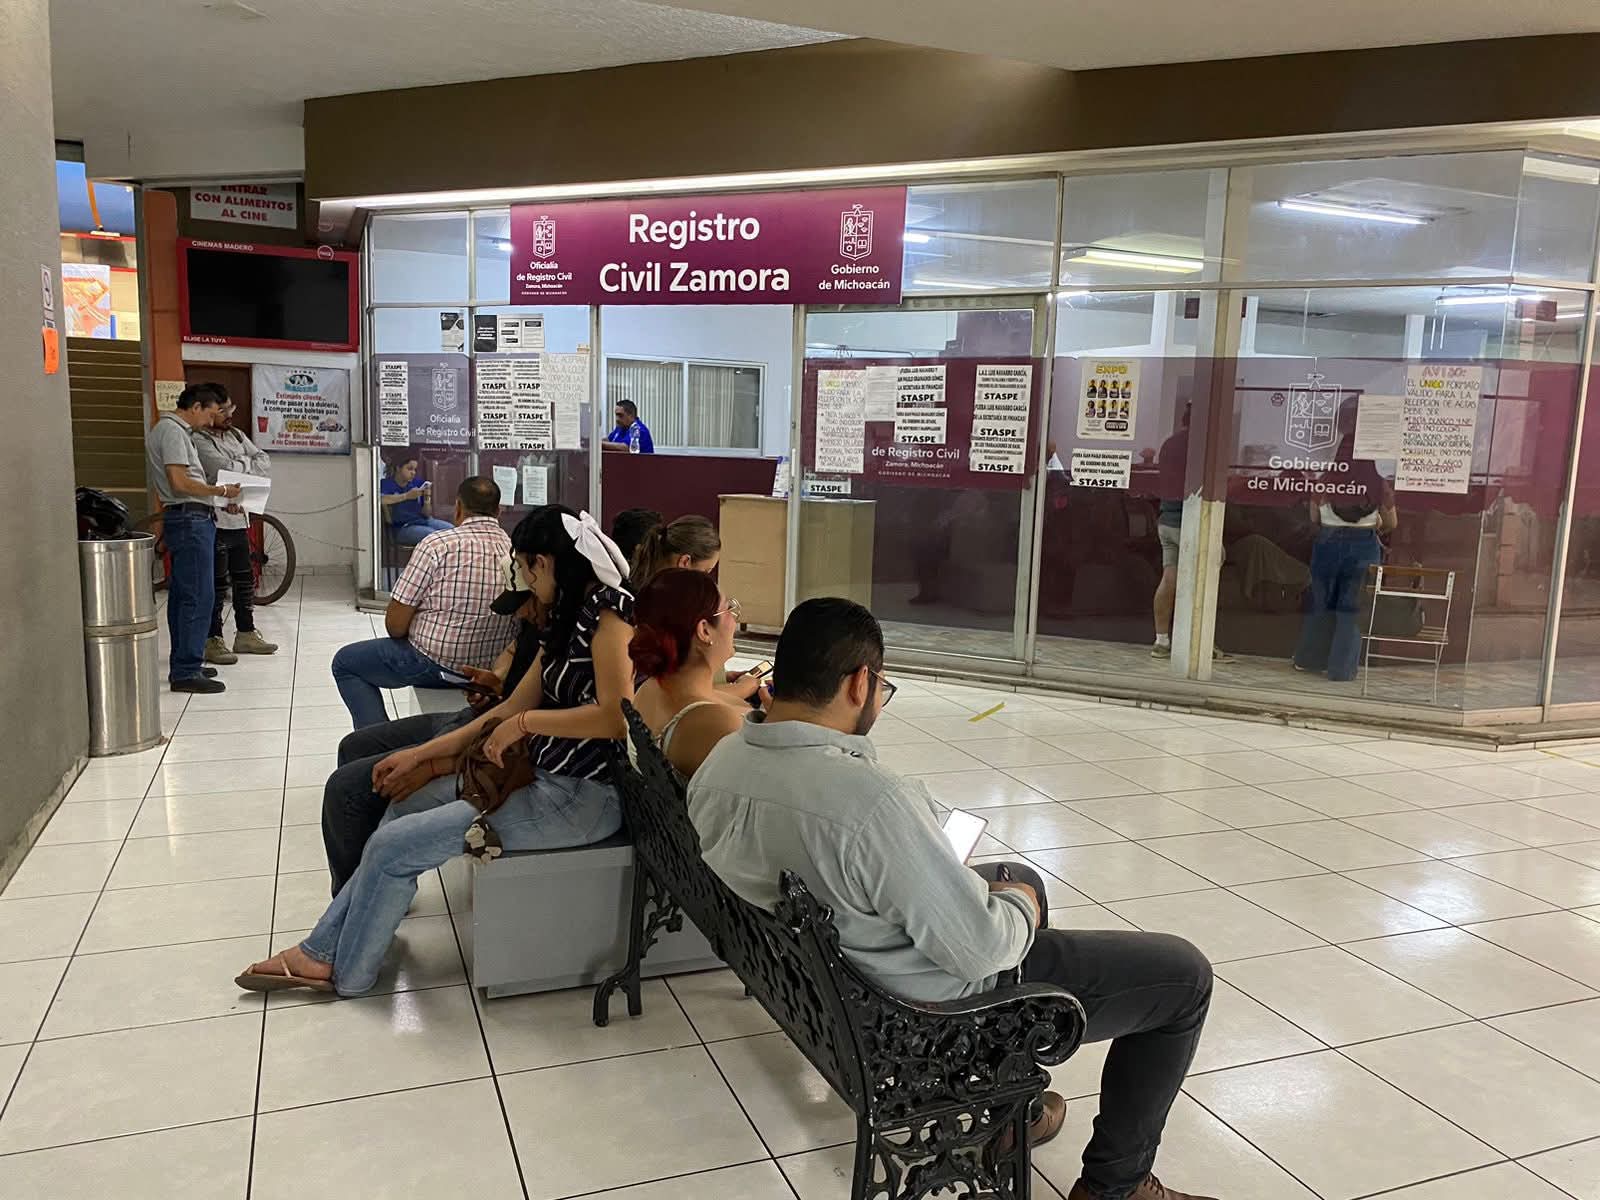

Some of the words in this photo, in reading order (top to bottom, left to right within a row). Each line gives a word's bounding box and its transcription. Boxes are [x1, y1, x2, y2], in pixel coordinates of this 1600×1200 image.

[195, 193, 220, 203] CON
[225, 196, 293, 211] ALIMENTOS
[221, 209, 236, 218] AL
[241, 211, 268, 221] CINE
[629, 211, 760, 249] Registro
[192, 240, 222, 249] CINEMAS
[224, 243, 253, 251] MADERO
[530, 261, 558, 269] Oficialía
[831, 264, 879, 274] Gobierno
[527, 273, 556, 282] Registro
[557, 272, 572, 280] Civil
[600, 262, 661, 292] Civil
[670, 262, 790, 292] Zamora
[819, 280, 832, 289] de
[834, 279, 890, 289] Michoacán
[1096, 365, 1128, 374] EXPO
[1408, 379, 1416, 387] EL
[1446, 381, 1479, 391] FORMATO
[1435, 390, 1455, 398] PARA
[1460, 391, 1472, 399] LA
[430, 414, 460, 423] Oficialía
[416, 427, 425, 435] de
[426, 427, 457, 437] Registro
[460, 428, 475, 437] Civil
[980, 428, 1016, 436] STASPE
[901, 435, 936, 443] STASPE
[872, 447, 885, 456] de
[888, 447, 933, 459] Registro
[937, 449, 960, 459] Civil
[911, 461, 944, 469] Michoacán
[978, 464, 1014, 472] STASPE
[1269, 456, 1349, 472] Gobierno
[1079, 478, 1118, 487] STASPE
[1248, 477, 1268, 490] de
[1273, 478, 1367, 495] Michoacán
